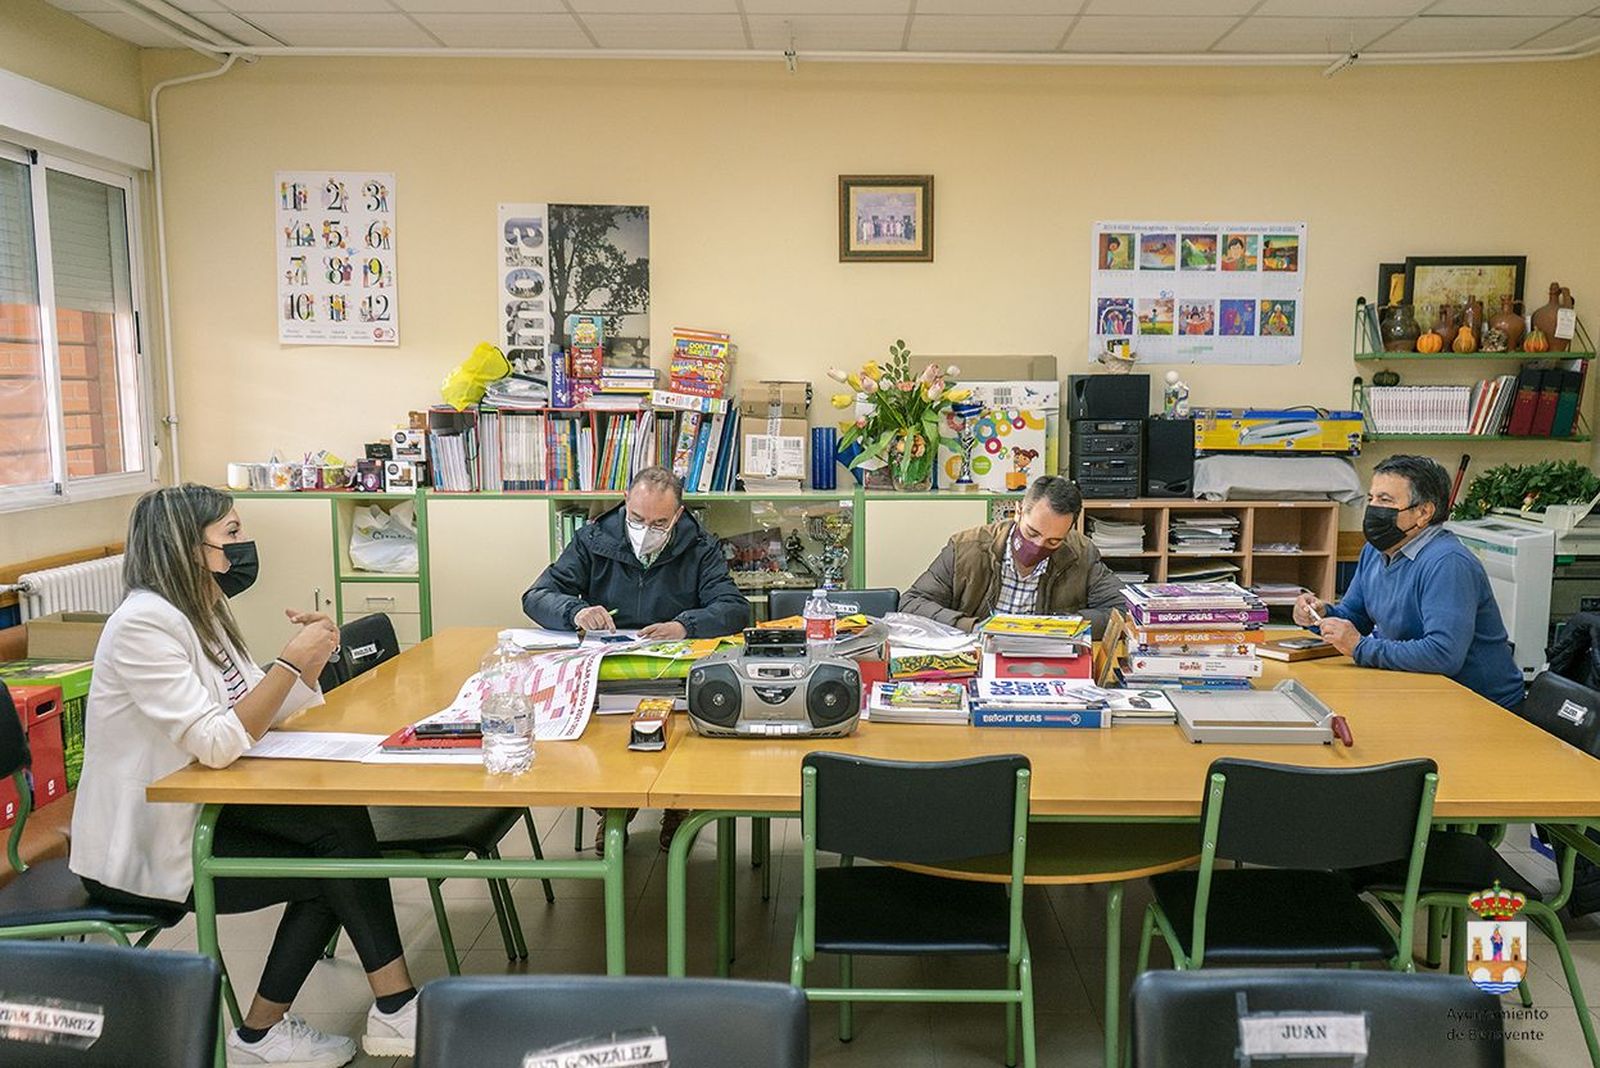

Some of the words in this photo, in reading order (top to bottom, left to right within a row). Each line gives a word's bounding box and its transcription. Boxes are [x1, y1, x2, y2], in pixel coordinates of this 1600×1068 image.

[326, 182, 342, 211] 2
[366, 182, 381, 212] 3
[328, 219, 343, 248] 5
[368, 220, 382, 249] 6
[329, 256, 344, 285] 8
[368, 256, 382, 285] 9
[289, 293, 311, 321] 10
[366, 294, 391, 322] 12
[504, 217, 545, 375] amora
[1187, 612, 1213, 621] IDEAS
[1183, 633, 1210, 642] IDEAS
[982, 713, 1014, 723] BRIGHT
[1015, 714, 1042, 723] IDEAS
[1281, 1024, 1327, 1040] JUAN
